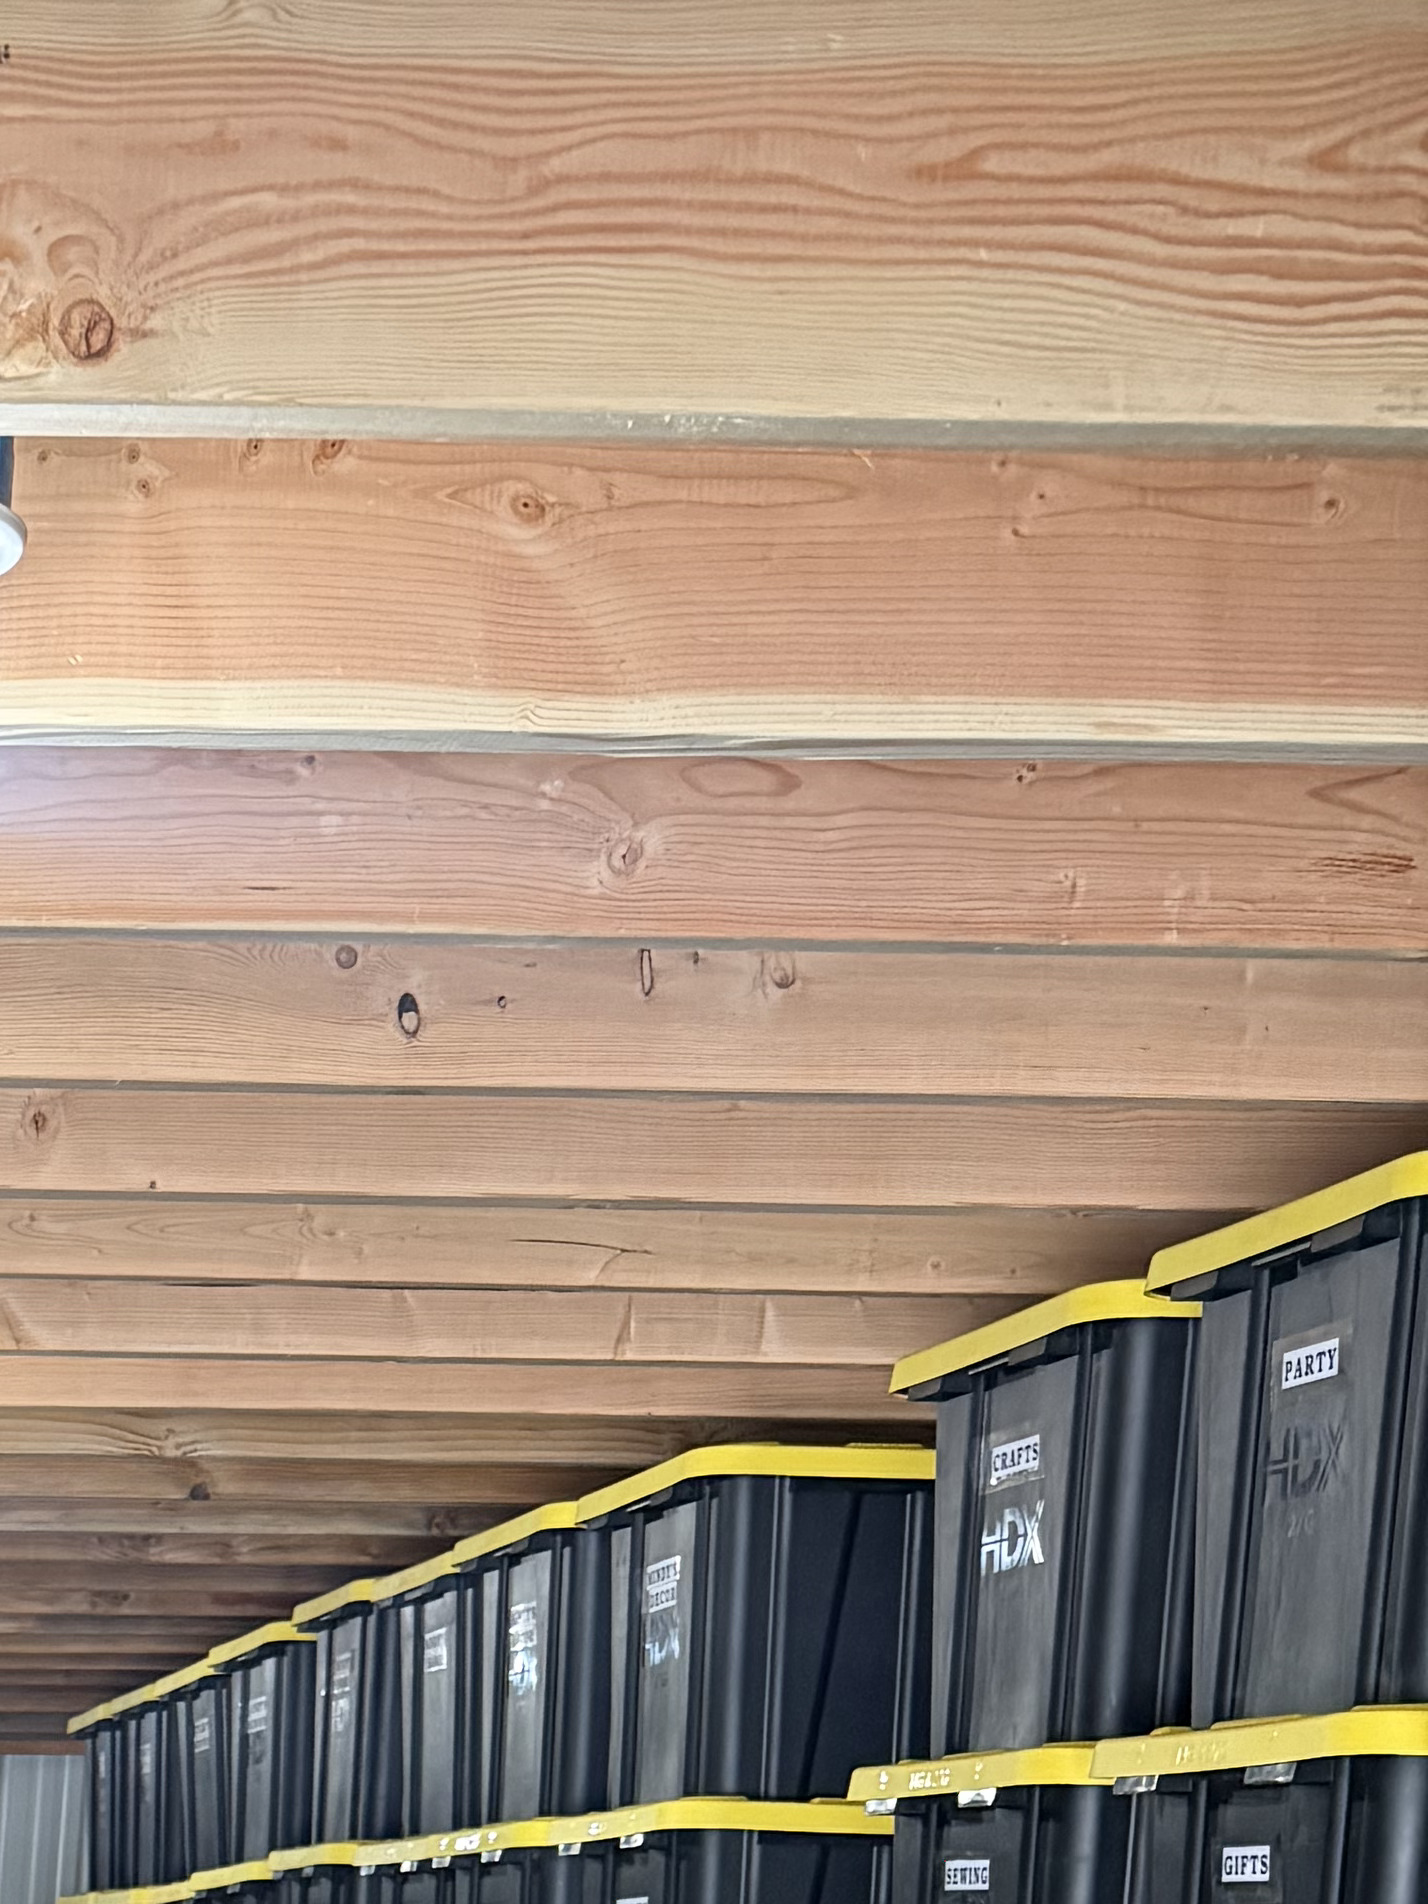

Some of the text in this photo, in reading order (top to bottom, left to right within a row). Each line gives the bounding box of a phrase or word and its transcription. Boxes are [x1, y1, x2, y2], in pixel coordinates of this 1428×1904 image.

[1284, 1347, 1338, 1384] PARTY
[992, 1442, 1039, 1475] CRAFTS
[981, 1499, 1045, 1577] HDX
[945, 1866, 988, 1888] SEWING
[1223, 1853, 1269, 1878] GIFTS
